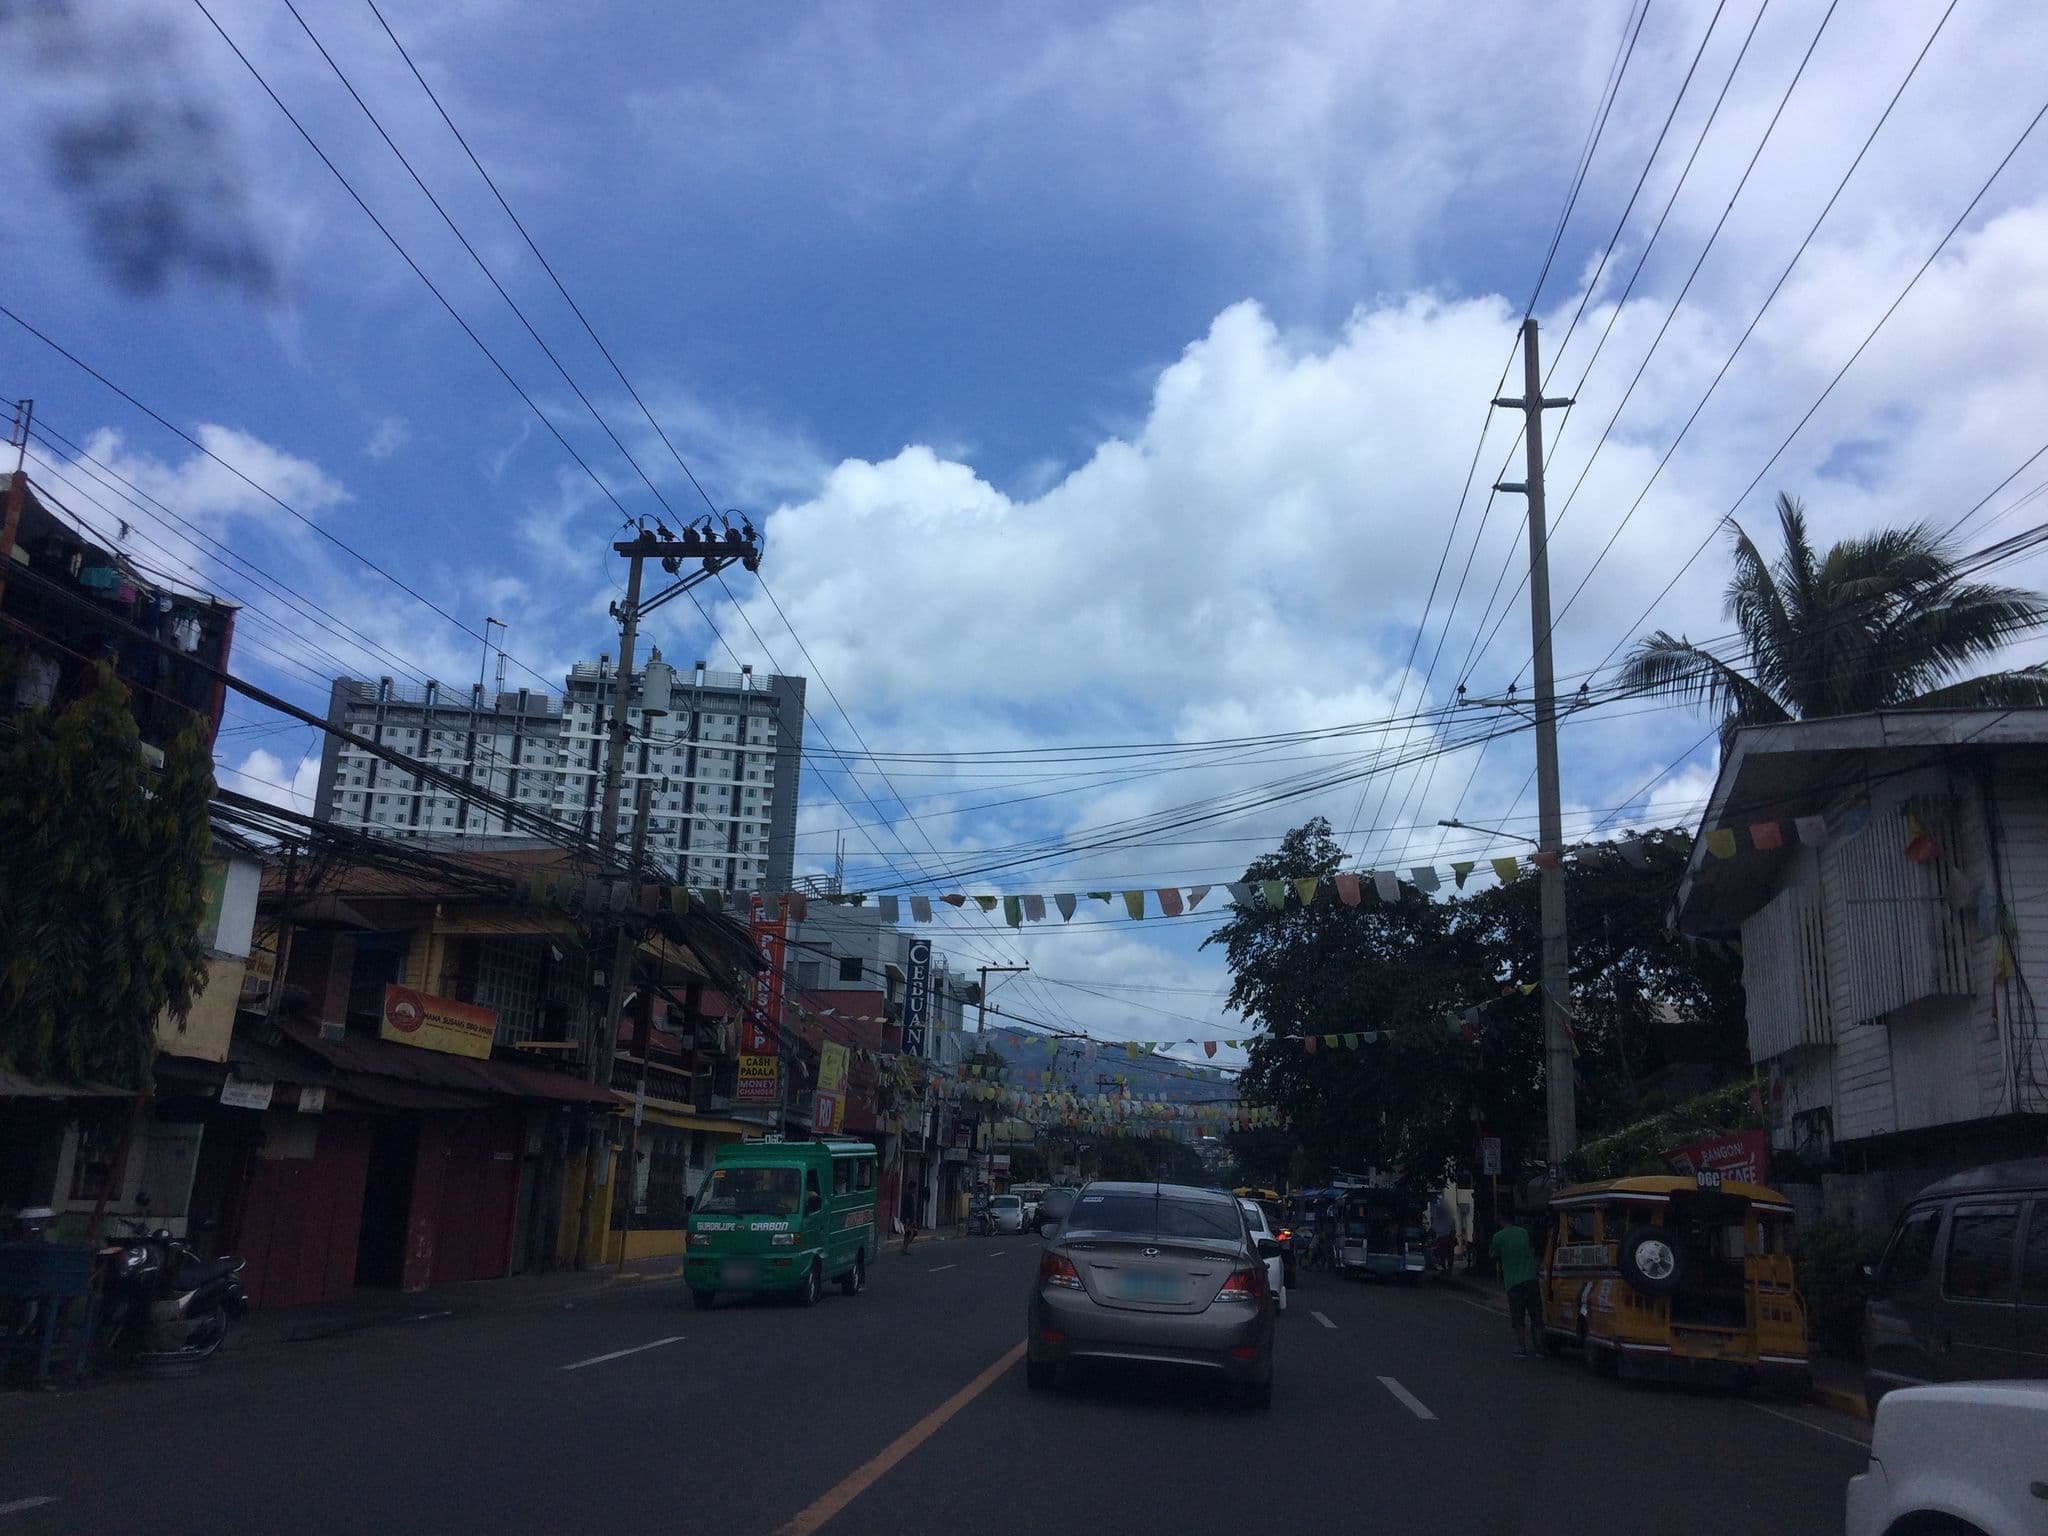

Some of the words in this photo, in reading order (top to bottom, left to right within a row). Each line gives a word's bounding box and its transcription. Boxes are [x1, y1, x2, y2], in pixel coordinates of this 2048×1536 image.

[907, 944, 930, 1057] CEBUANA
[746, 1057, 770, 1067] CASH
[740, 1067, 775, 1076] PADALA
[740, 1079, 774, 1088] MONEY
[1701, 1142, 1744, 1163] BANGON!
[696, 1221, 737, 1232] GUADALUPE
[750, 1221, 789, 1232] CARBON
